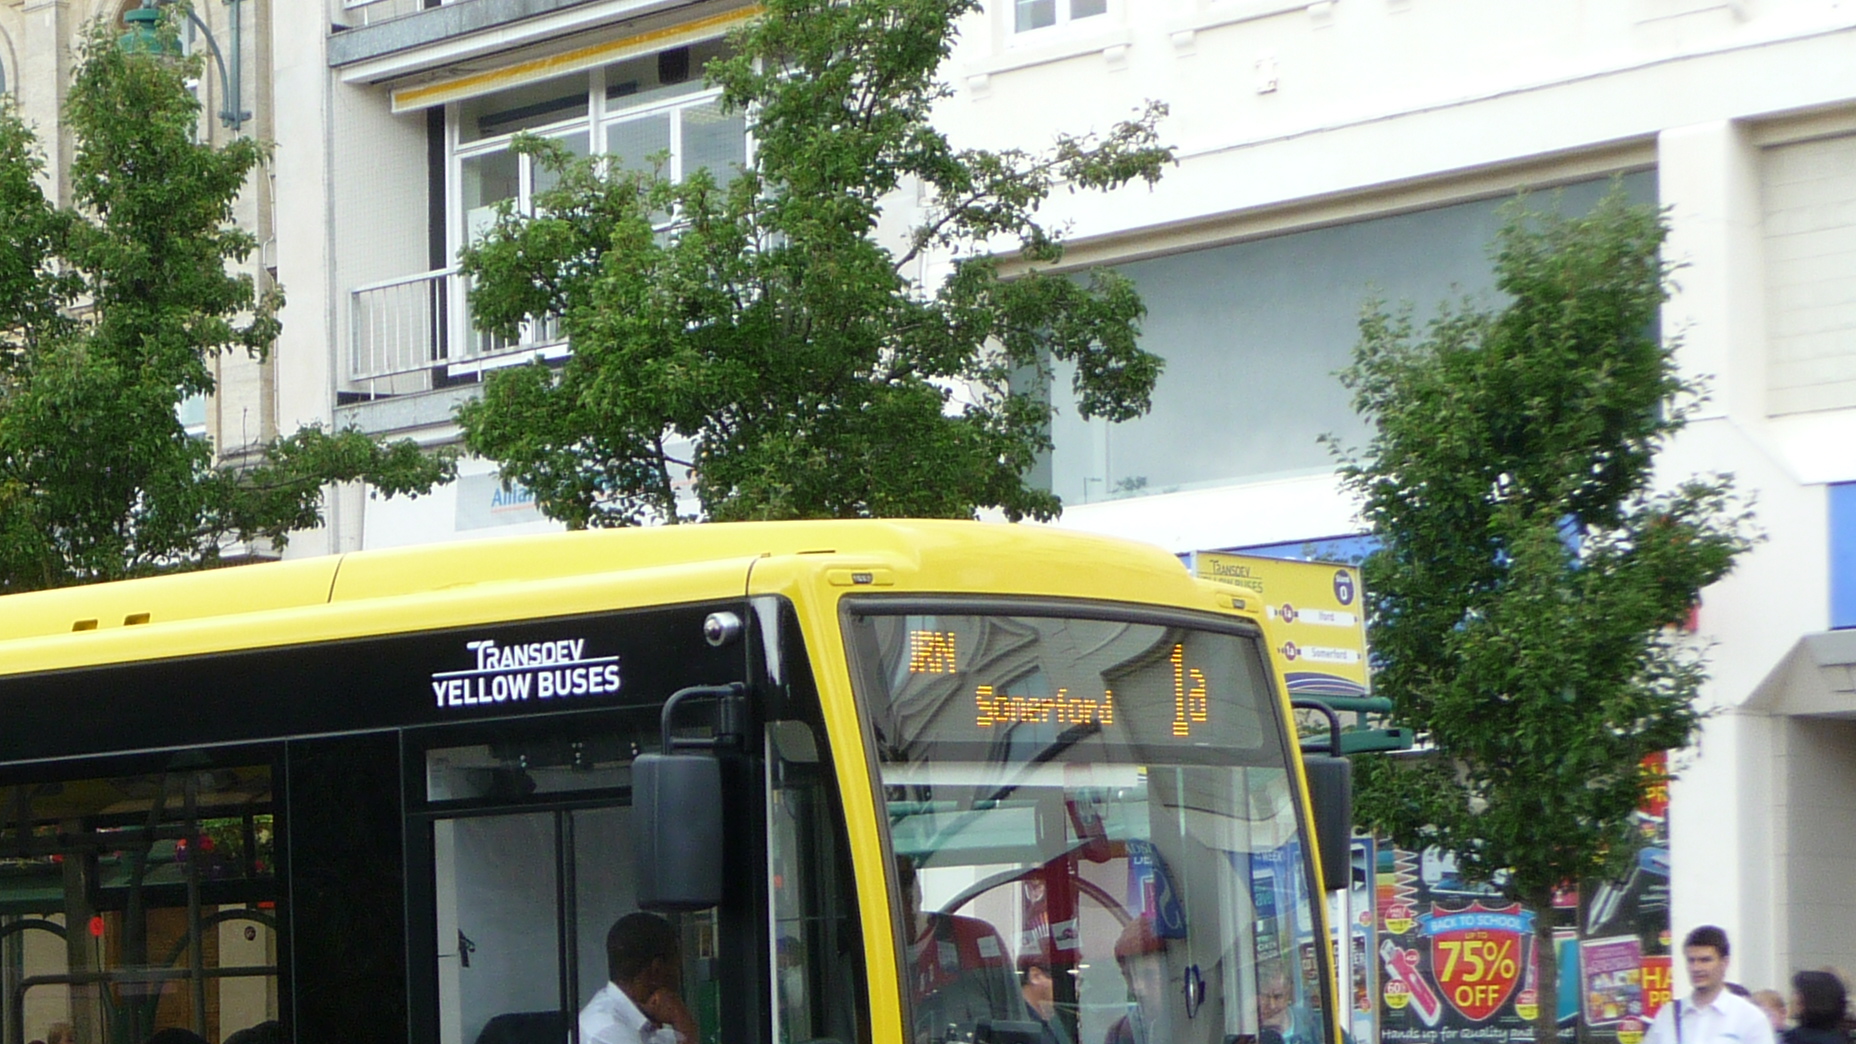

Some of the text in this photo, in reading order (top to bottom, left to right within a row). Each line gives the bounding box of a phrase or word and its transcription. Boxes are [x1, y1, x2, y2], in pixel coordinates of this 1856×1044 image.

[466, 638, 586, 671] TRANSDEV
[432, 665, 621, 708] YELLOW BUSES
[975, 684, 1114, 728] Somerford
[1430, 915, 1522, 932] BACK TO SCHOOL
[1465, 932, 1476, 940] UP
[1438, 939, 1515, 983] 75%
[1455, 985, 1500, 1007] OFF
[1382, 1025, 1536, 1043] Hands up for Quality and
